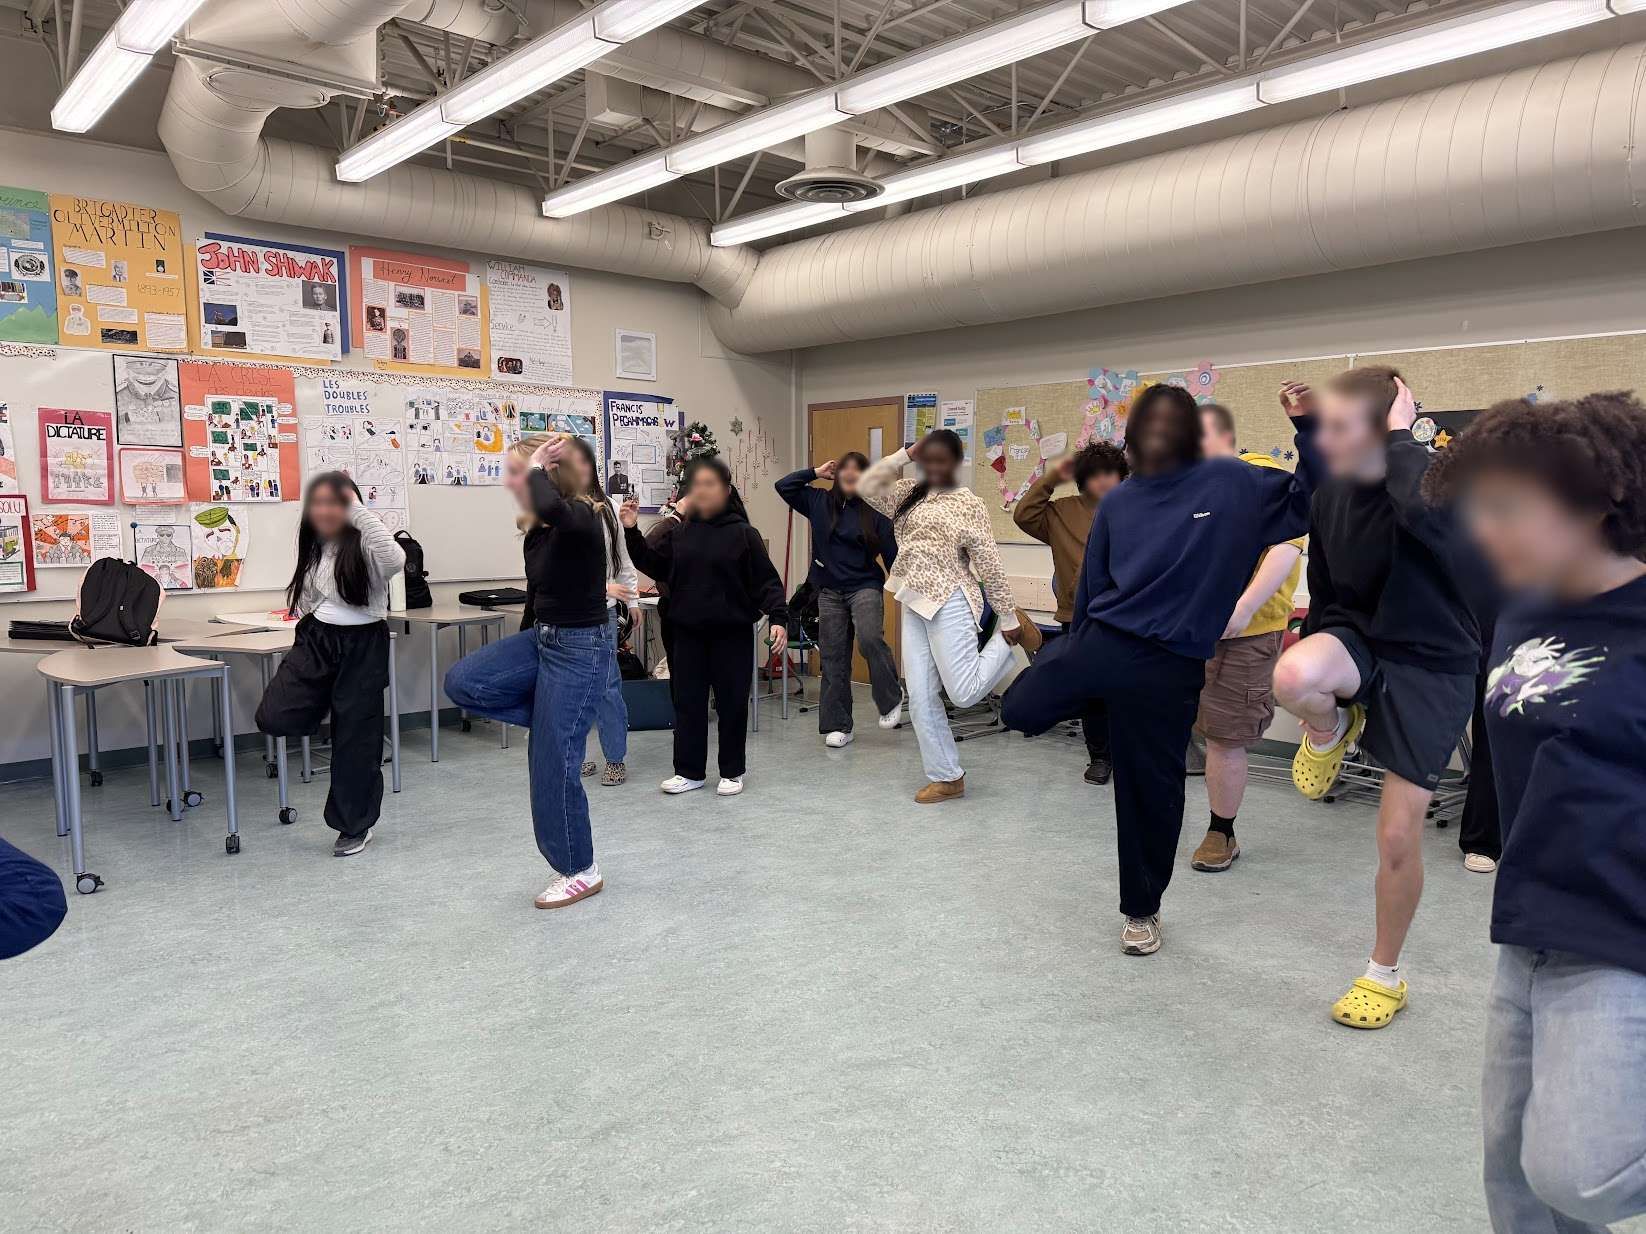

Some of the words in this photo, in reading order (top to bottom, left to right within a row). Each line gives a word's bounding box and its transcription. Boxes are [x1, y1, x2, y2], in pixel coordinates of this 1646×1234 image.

[73, 199, 156, 223] BRIGADIER
[68, 223, 165, 251] MARTIN
[198, 242, 260, 274] JOHN
[263, 251, 337, 284] SHIWAK
[381, 261, 413, 284] Henry
[230, 366, 281, 387] CRISE
[322, 379, 340, 389] LES
[323, 390, 368, 401] DOUBLES
[325, 403, 370, 415] TROUBLES
[610, 400, 644, 415] FRANCIS
[64, 411, 84, 426] LA
[46, 424, 106, 441] DICTATURE
